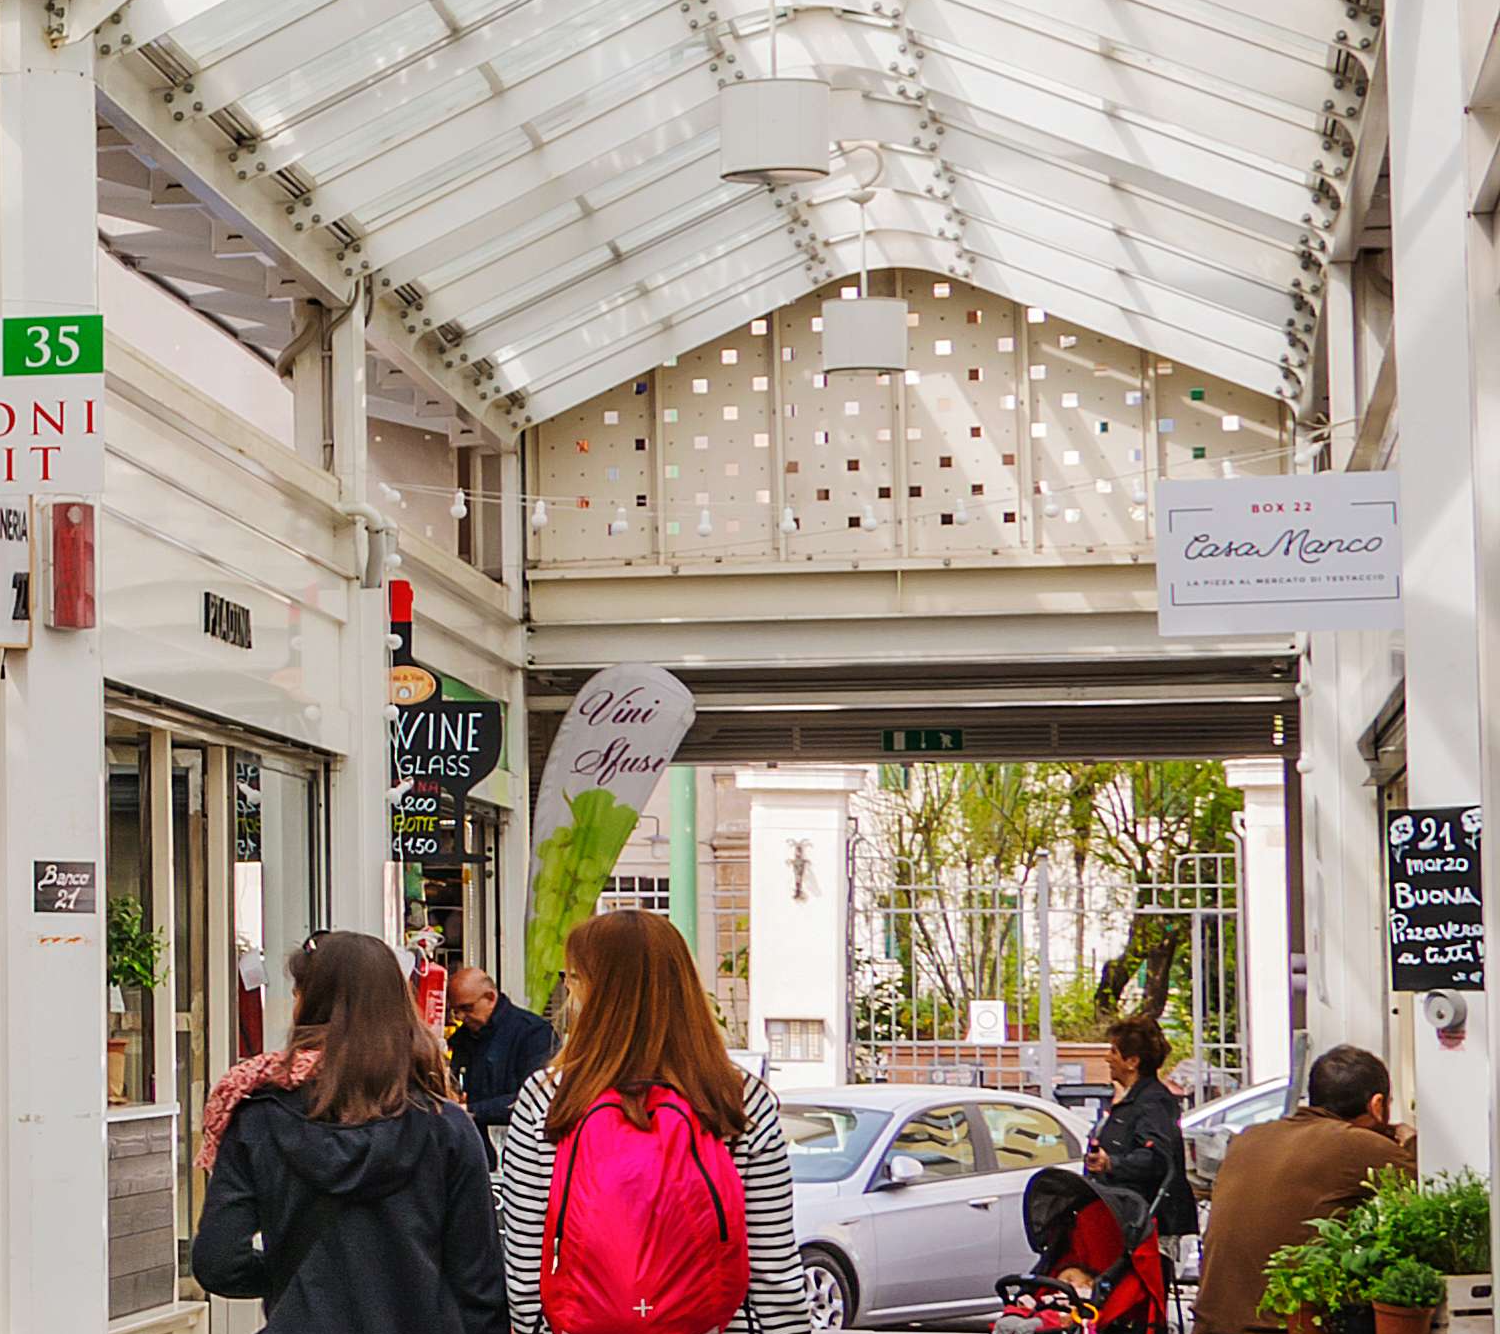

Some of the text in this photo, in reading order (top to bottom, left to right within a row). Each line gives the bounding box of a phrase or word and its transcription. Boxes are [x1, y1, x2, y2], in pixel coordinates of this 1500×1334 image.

[24, 325, 80, 368] 35
[1252, 501, 1313, 515] BOX 22
[1255, 576, 1307, 586] MERCATO
[1325, 573, 1386, 583] TESTACCIO
[579, 687, 660, 726] Vini
[399, 755, 471, 777] GLASS
[570, 736, 669, 786] Sfusi
[1418, 817, 1456, 851] 21
[38, 864, 90, 891] Banco
[1406, 857, 1469, 876] marzo
[54, 887, 82, 910] 21
[1394, 882, 1482, 910] BUONA
[1397, 951, 1422, 965] a
